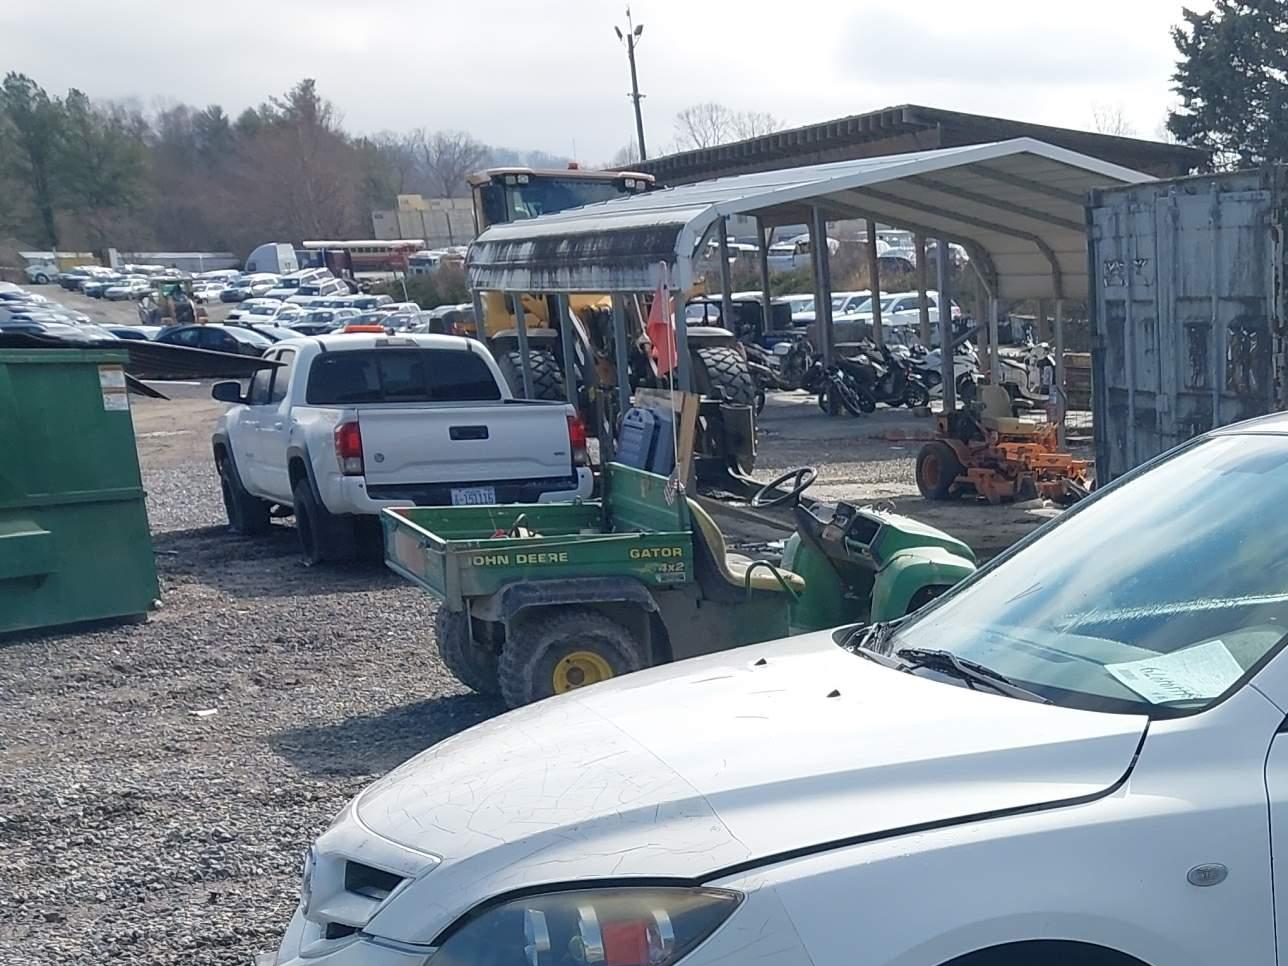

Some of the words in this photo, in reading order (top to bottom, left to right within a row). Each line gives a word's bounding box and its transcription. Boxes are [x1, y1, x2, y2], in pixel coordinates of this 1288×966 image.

[516, 552, 569, 564] DEERE
[630, 547, 682, 559] GATOR
[658, 561, 685, 572] 4x2
